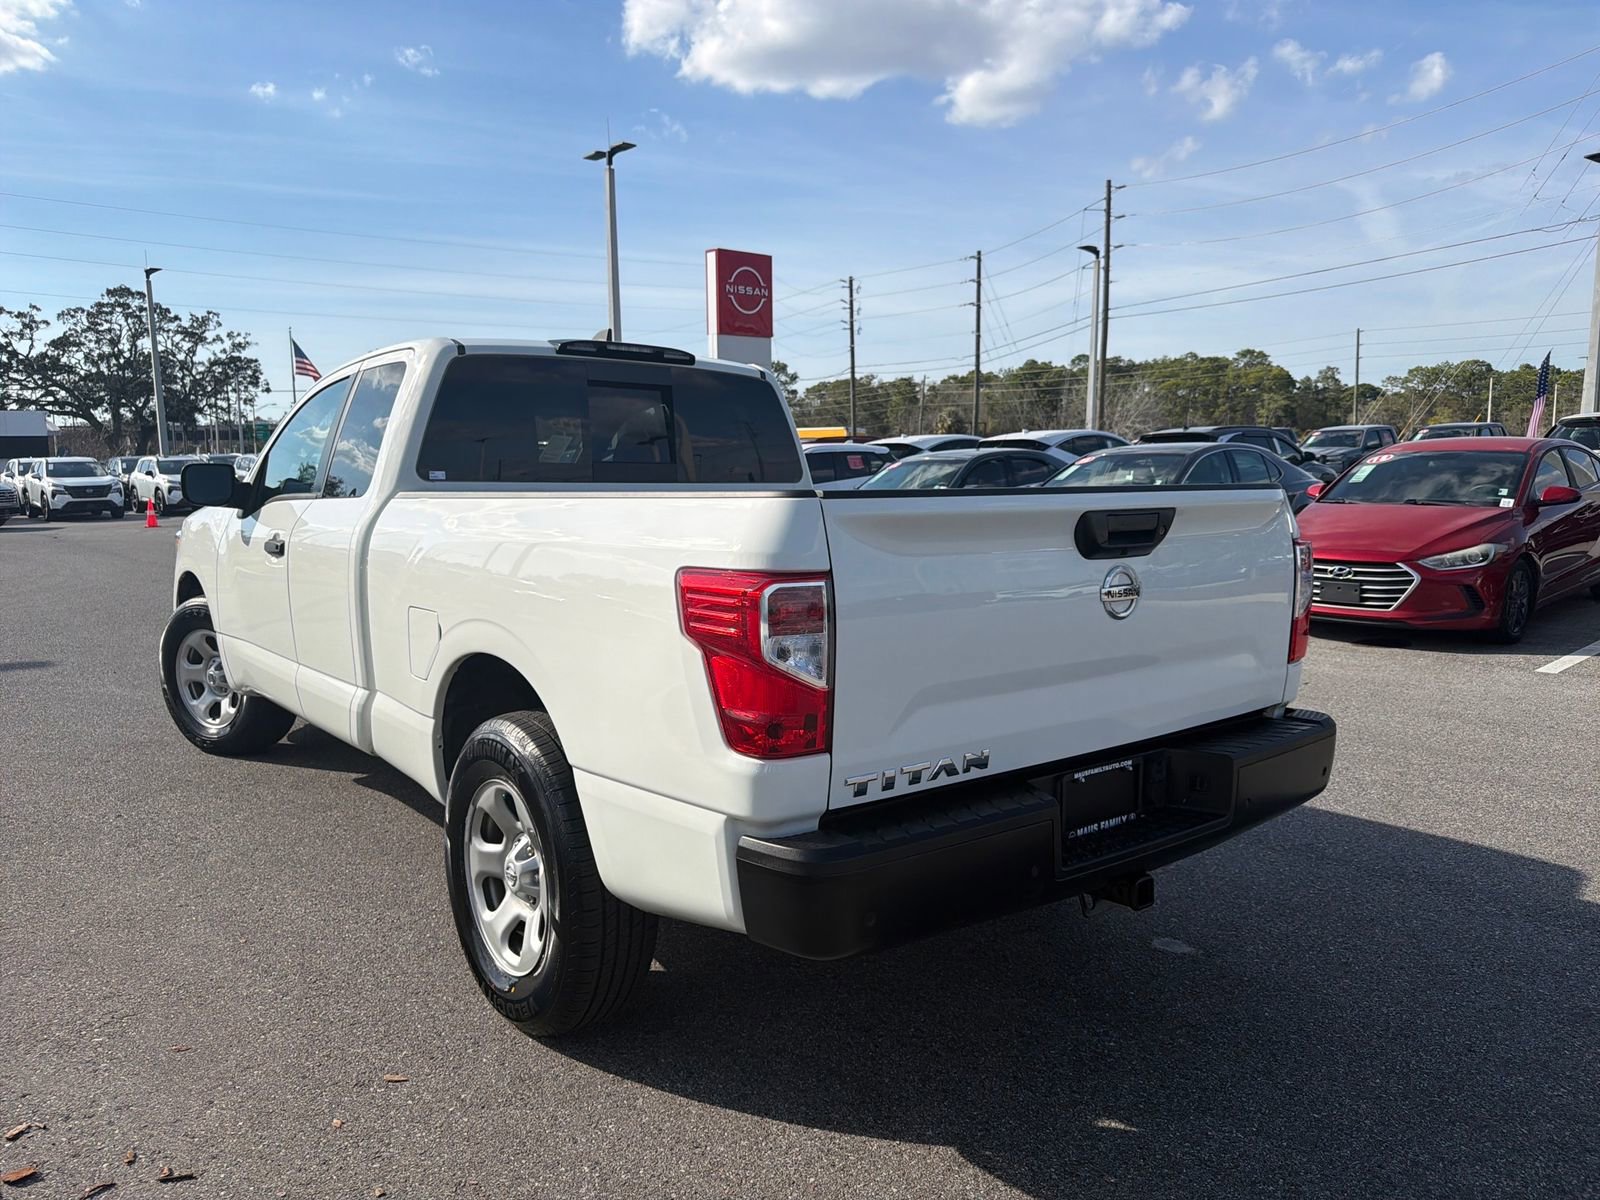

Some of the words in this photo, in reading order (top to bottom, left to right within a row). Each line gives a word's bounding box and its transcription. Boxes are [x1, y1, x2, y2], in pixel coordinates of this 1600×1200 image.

[725, 284, 769, 297] NISSAN
[1106, 588, 1138, 599] NISSAN
[844, 749, 990, 798] TITAN
[1073, 759, 1133, 779] MAUSFAMILYAUTO.COM
[1076, 823, 1099, 837] MAUS
[1100, 815, 1128, 831] FAMILY
